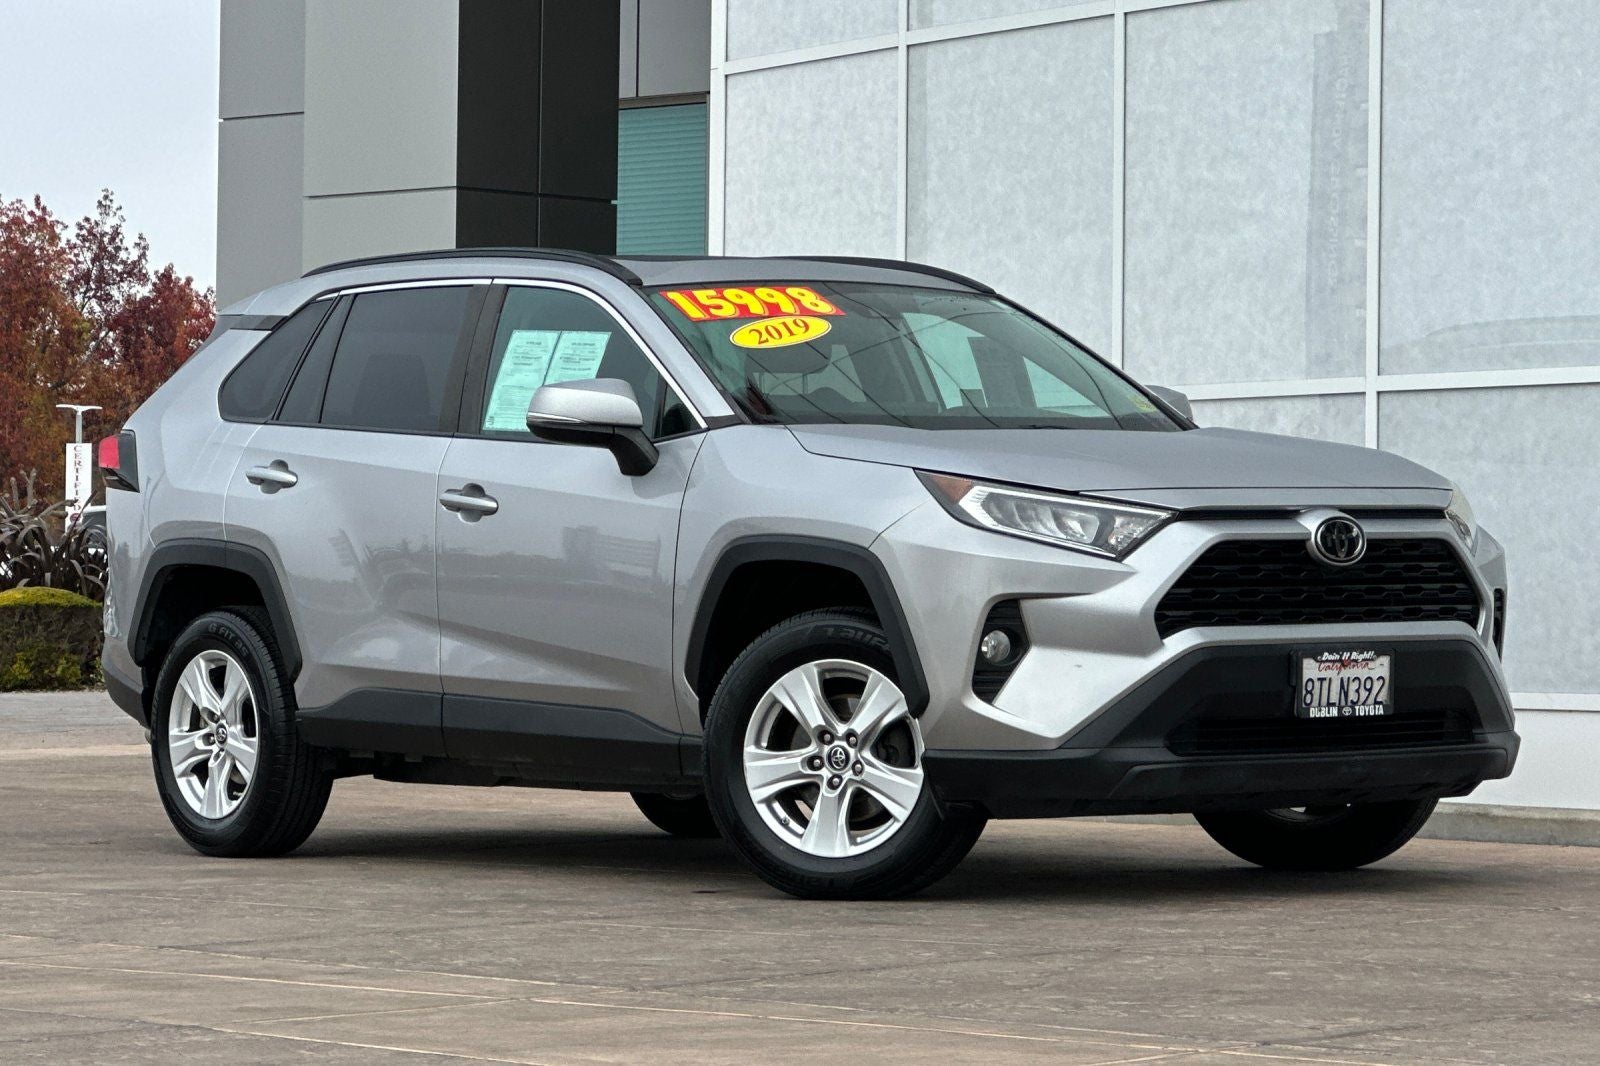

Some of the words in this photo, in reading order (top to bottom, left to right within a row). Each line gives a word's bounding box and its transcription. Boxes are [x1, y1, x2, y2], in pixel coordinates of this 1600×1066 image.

[666, 286, 835, 320] 15998
[749, 318, 811, 345] 2019
[1351, 651, 1375, 662] Right!
[1317, 661, 1375, 675] California
[1303, 676, 1386, 707] 8TLN392
[1310, 706, 1338, 718] DUBLIN
[1355, 704, 1384, 717] TOYOTA
